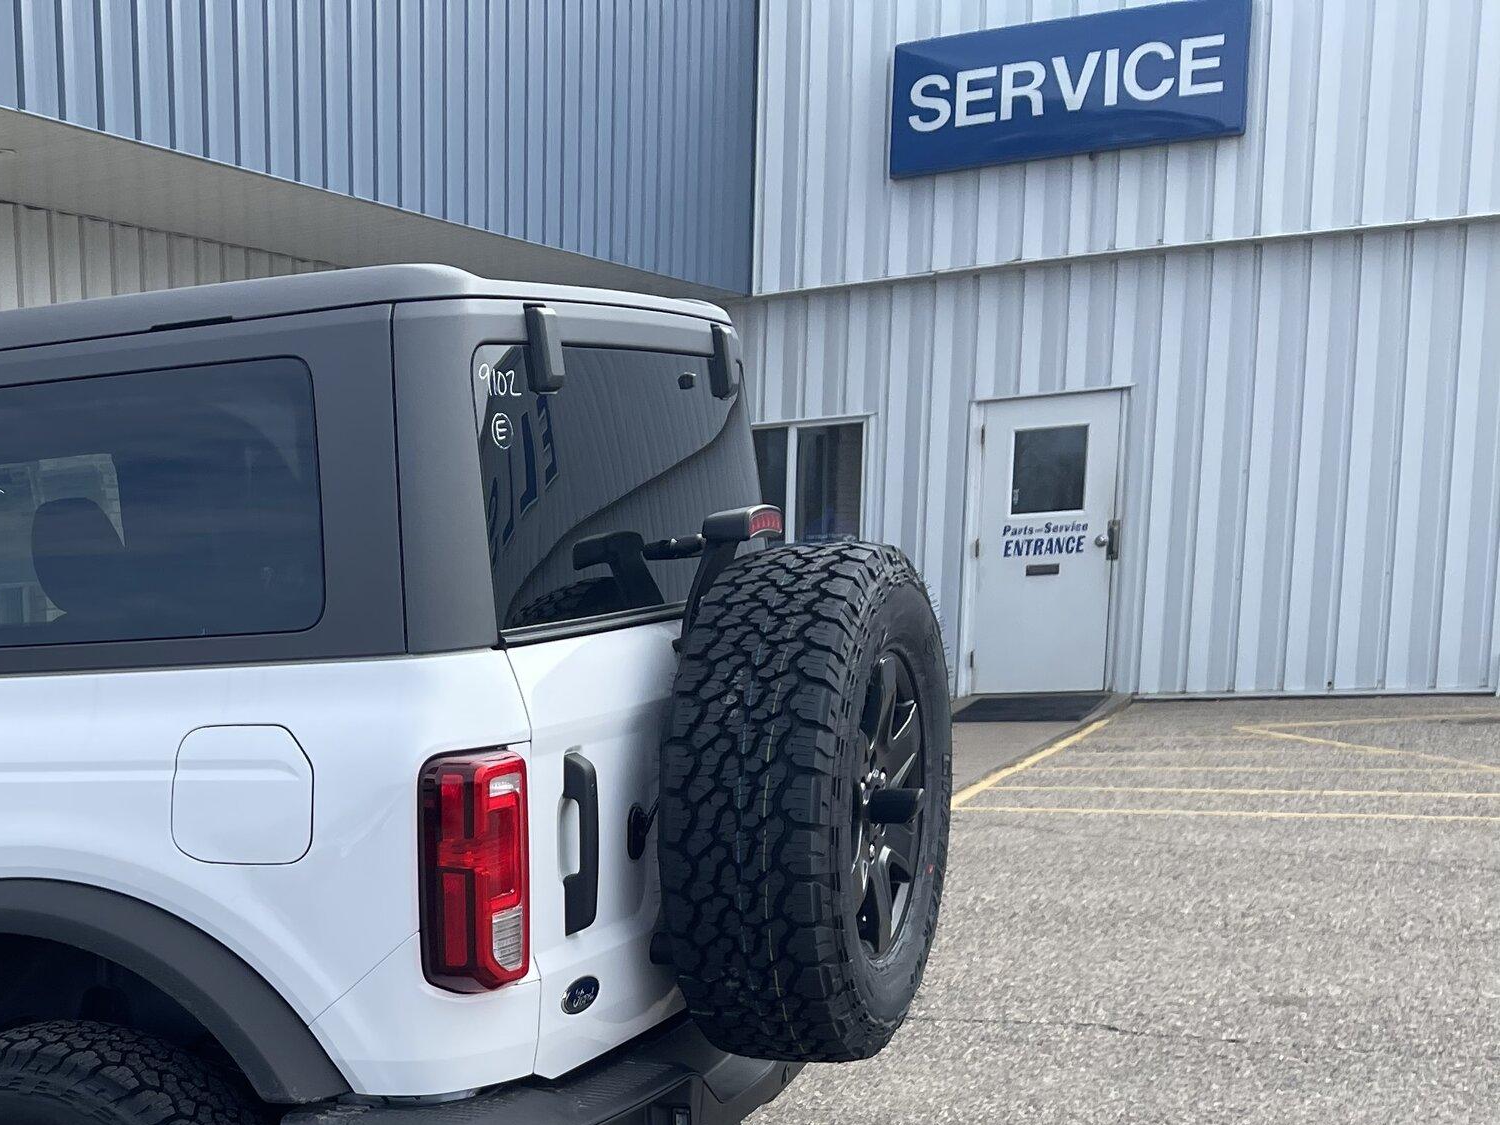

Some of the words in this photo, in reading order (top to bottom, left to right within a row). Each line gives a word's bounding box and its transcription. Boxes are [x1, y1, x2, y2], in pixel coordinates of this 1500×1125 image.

[908, 34, 1225, 132] SERVICE
[478, 363, 522, 396] 9102
[1003, 535, 1086, 557] ENTRANCE
